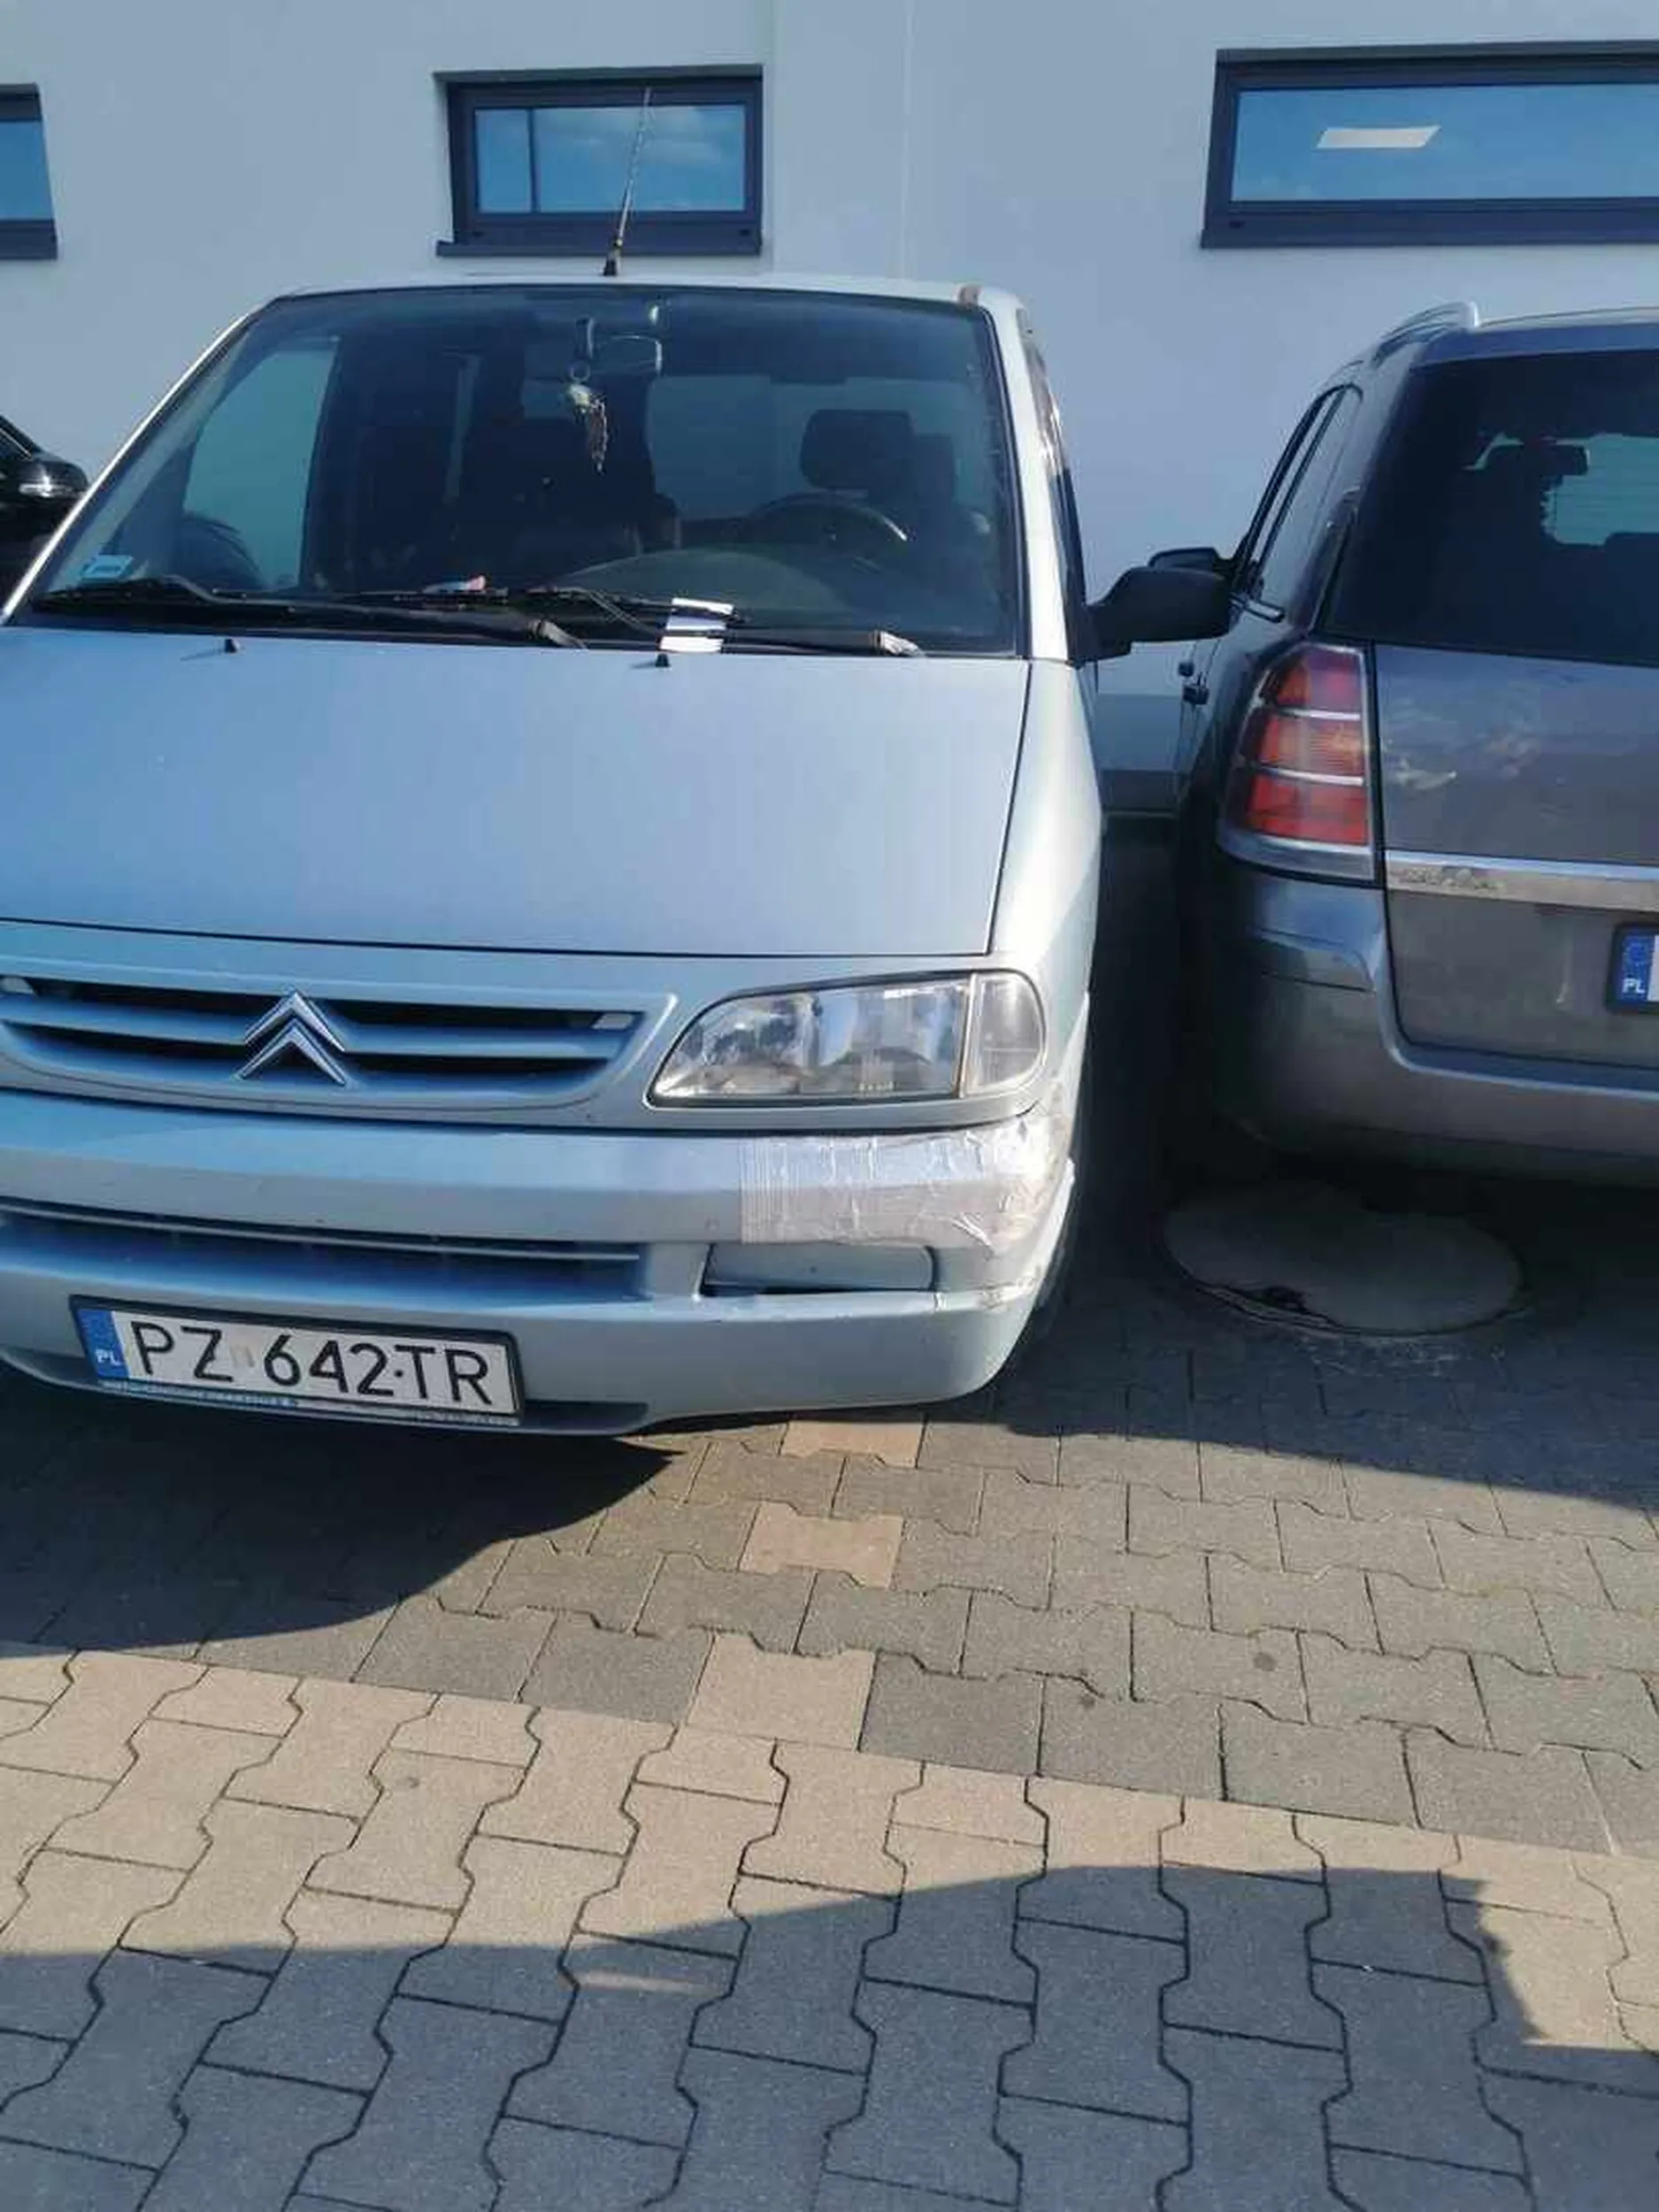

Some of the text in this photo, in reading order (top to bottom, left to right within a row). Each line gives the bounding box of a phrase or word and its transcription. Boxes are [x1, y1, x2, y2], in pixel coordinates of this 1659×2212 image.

[1622, 978, 1646, 994] PL
[95, 1348, 122, 1366] PL
[130, 1320, 234, 1382] PZ
